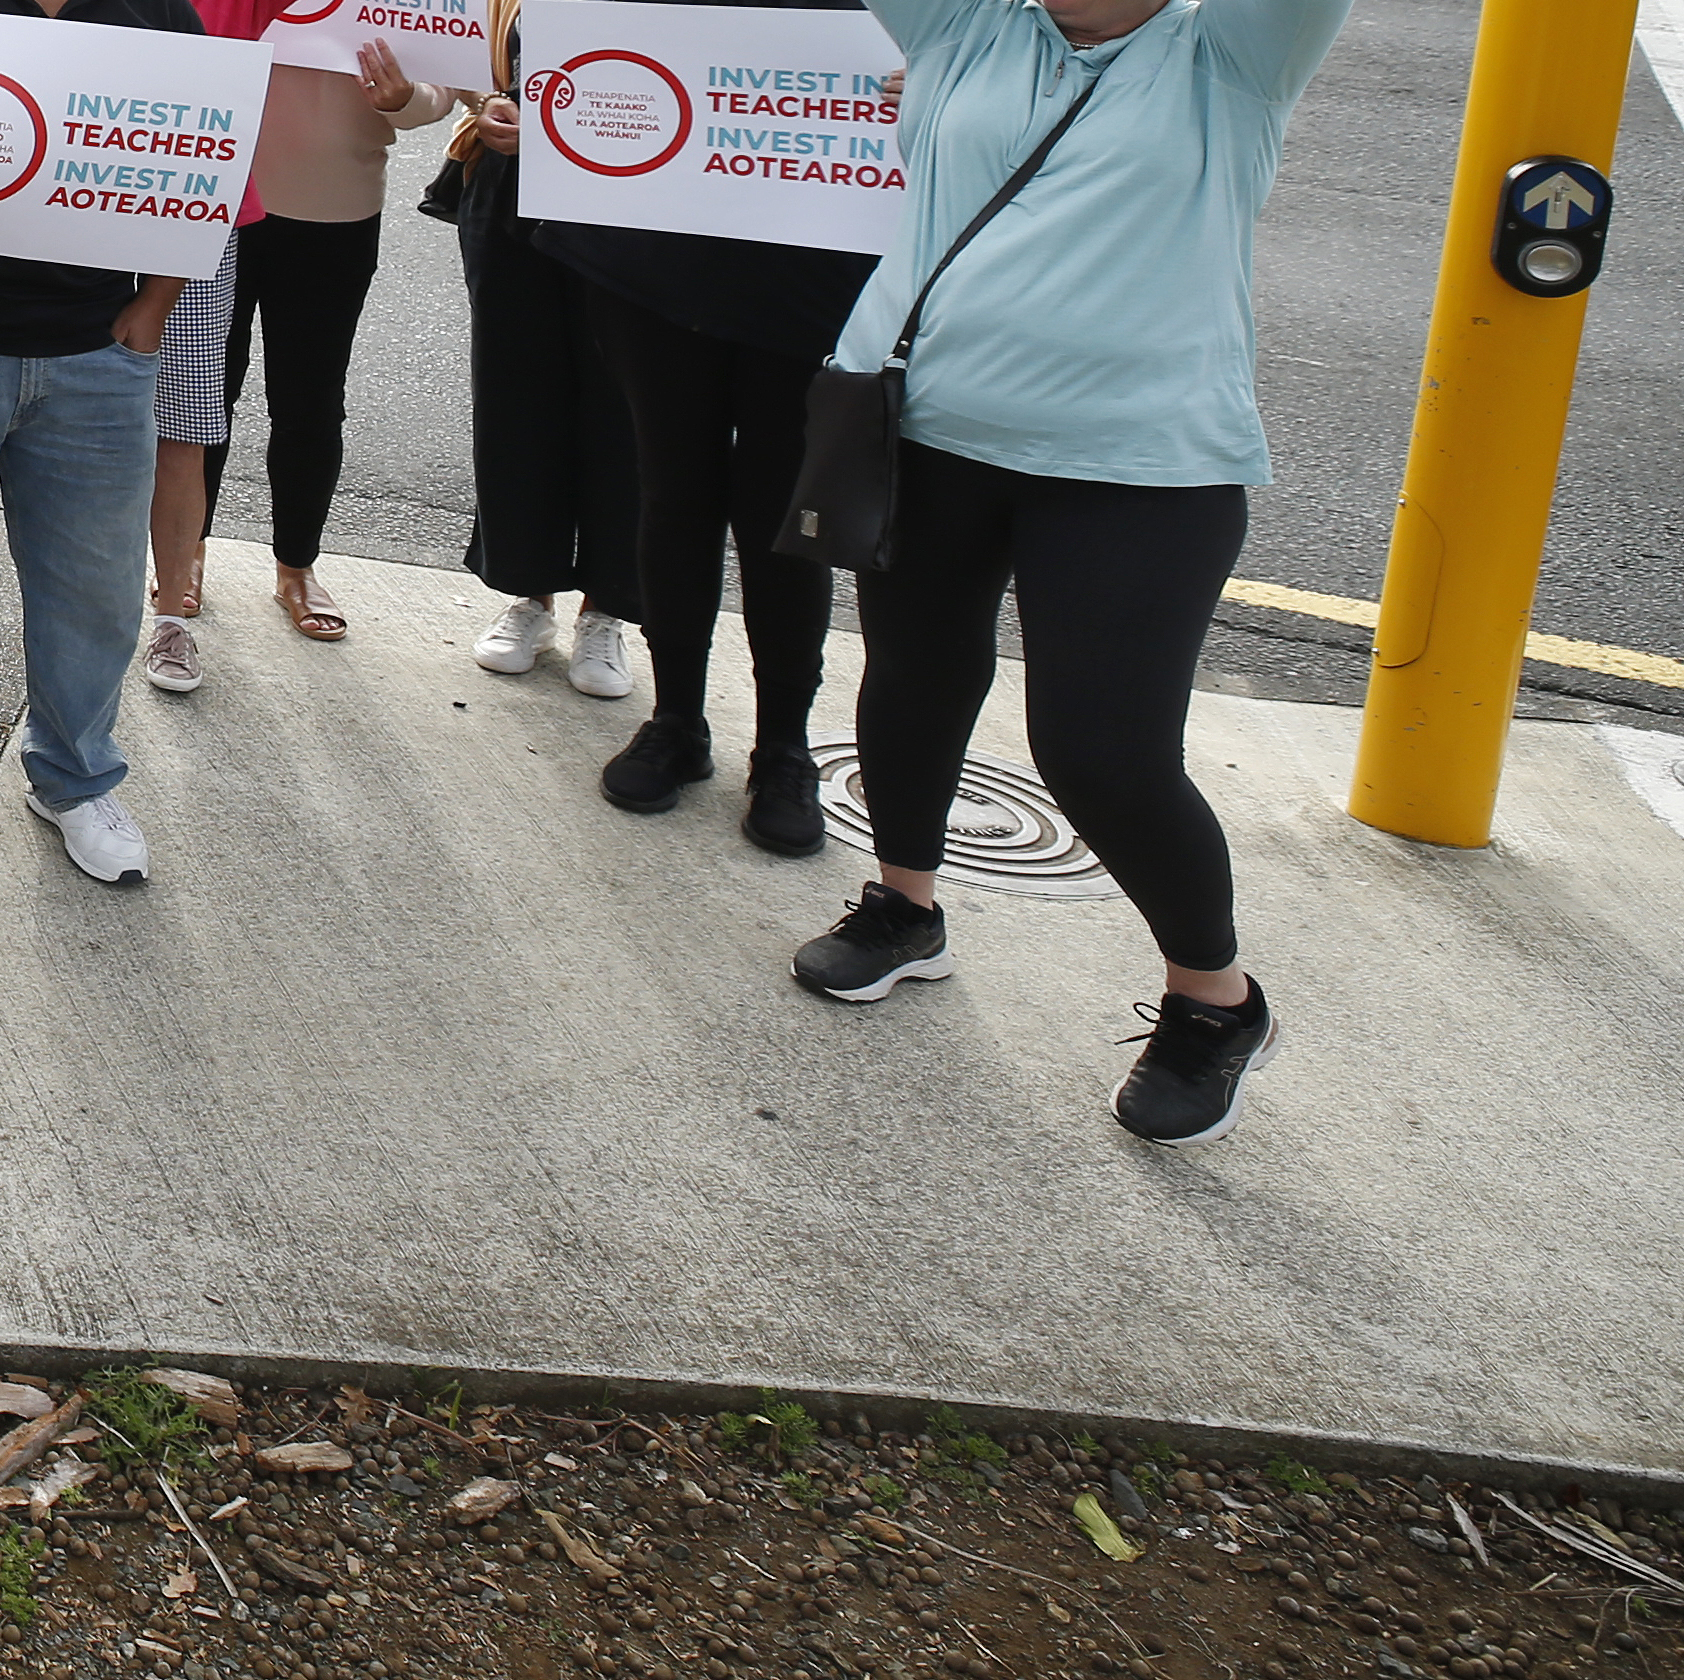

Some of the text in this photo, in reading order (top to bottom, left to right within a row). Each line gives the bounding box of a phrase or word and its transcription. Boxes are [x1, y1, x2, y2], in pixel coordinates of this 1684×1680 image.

[356, 6, 485, 40] AOTEAROA
[708, 66, 888, 95] INVEST IN
[67, 93, 233, 132] INVEST IN
[706, 91, 898, 124] TEACHERS
[63, 122, 236, 161] TEACHERS
[707, 126, 885, 161] INVEST IN
[54, 160, 218, 196] INVEST IN
[703, 152, 906, 190] AOTEAROA
[45, 187, 230, 224] AOTEAROA
